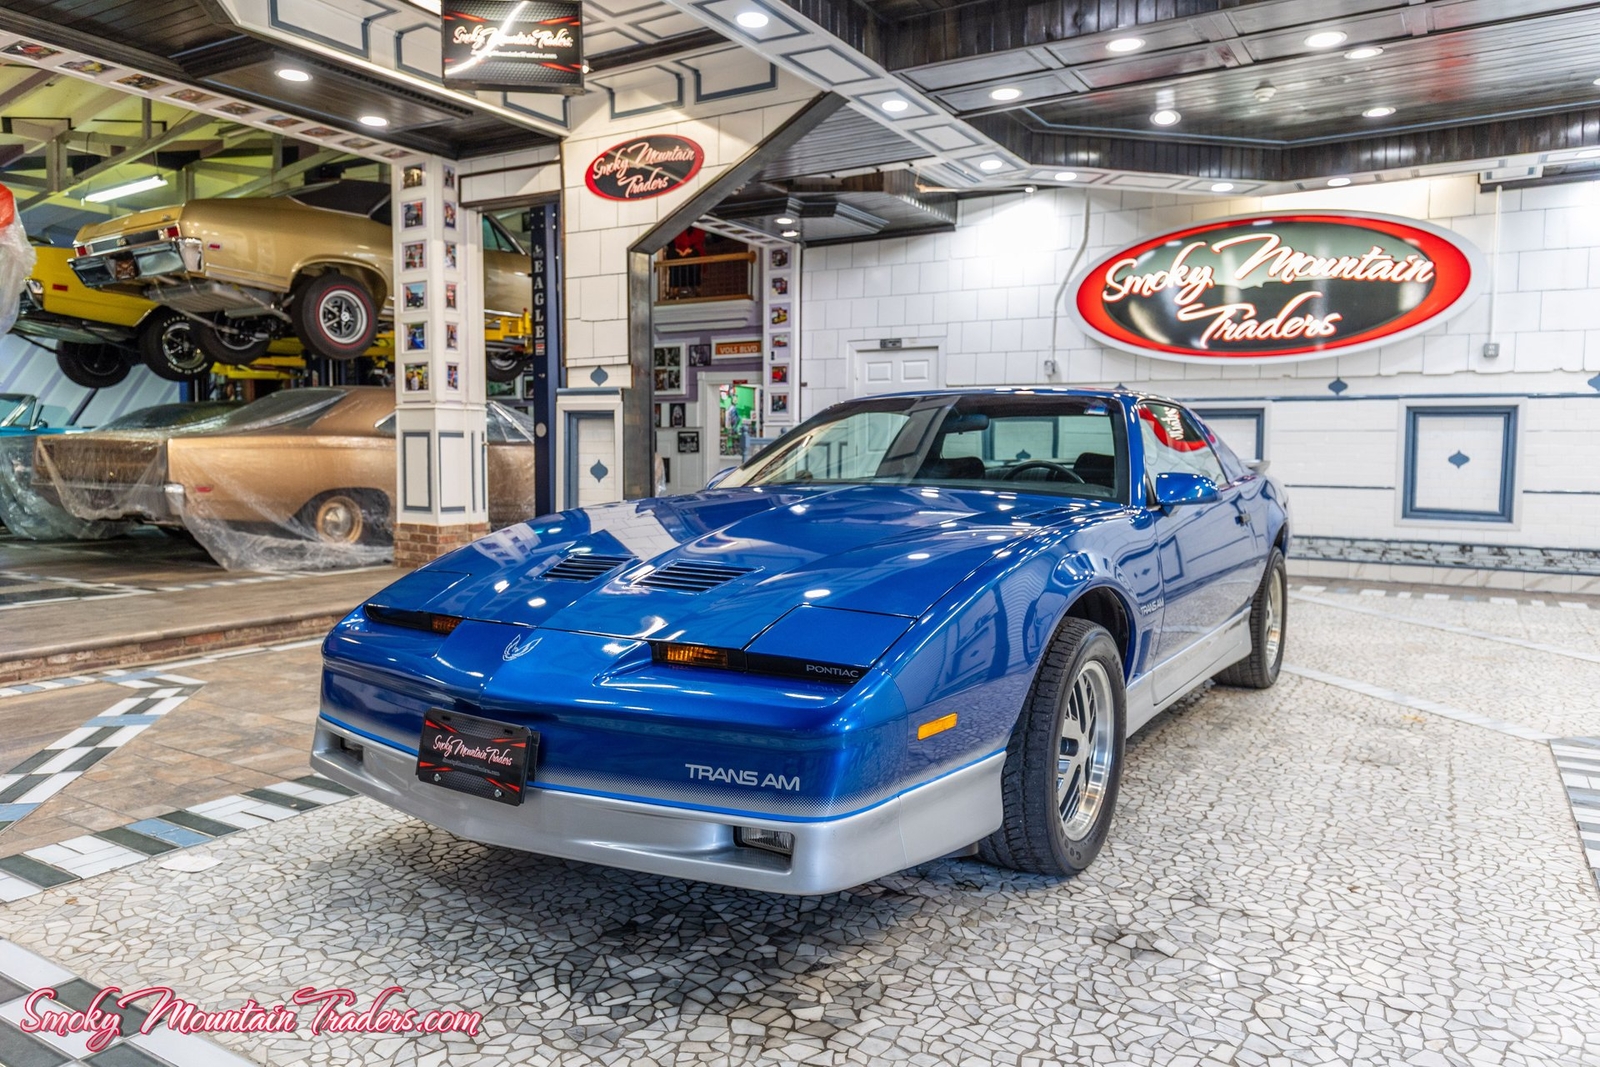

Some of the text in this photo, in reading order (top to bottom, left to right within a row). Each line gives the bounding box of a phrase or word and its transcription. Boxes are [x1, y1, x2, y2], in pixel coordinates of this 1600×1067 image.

[532, 28, 574, 48] Traders
[592, 142, 695, 180] Smoky Mountain
[617, 167, 670, 198] Traders
[1102, 232, 1437, 306] Smoky Mountain
[534, 260, 545, 338] EAGLE
[1177, 291, 1344, 350] Traders
[719, 345, 758, 354] VOLS BLVD
[806, 664, 859, 678] PONTIAC
[432, 735, 513, 766] Smoky Mountain Traders
[685, 763, 800, 792] TRANS AM
